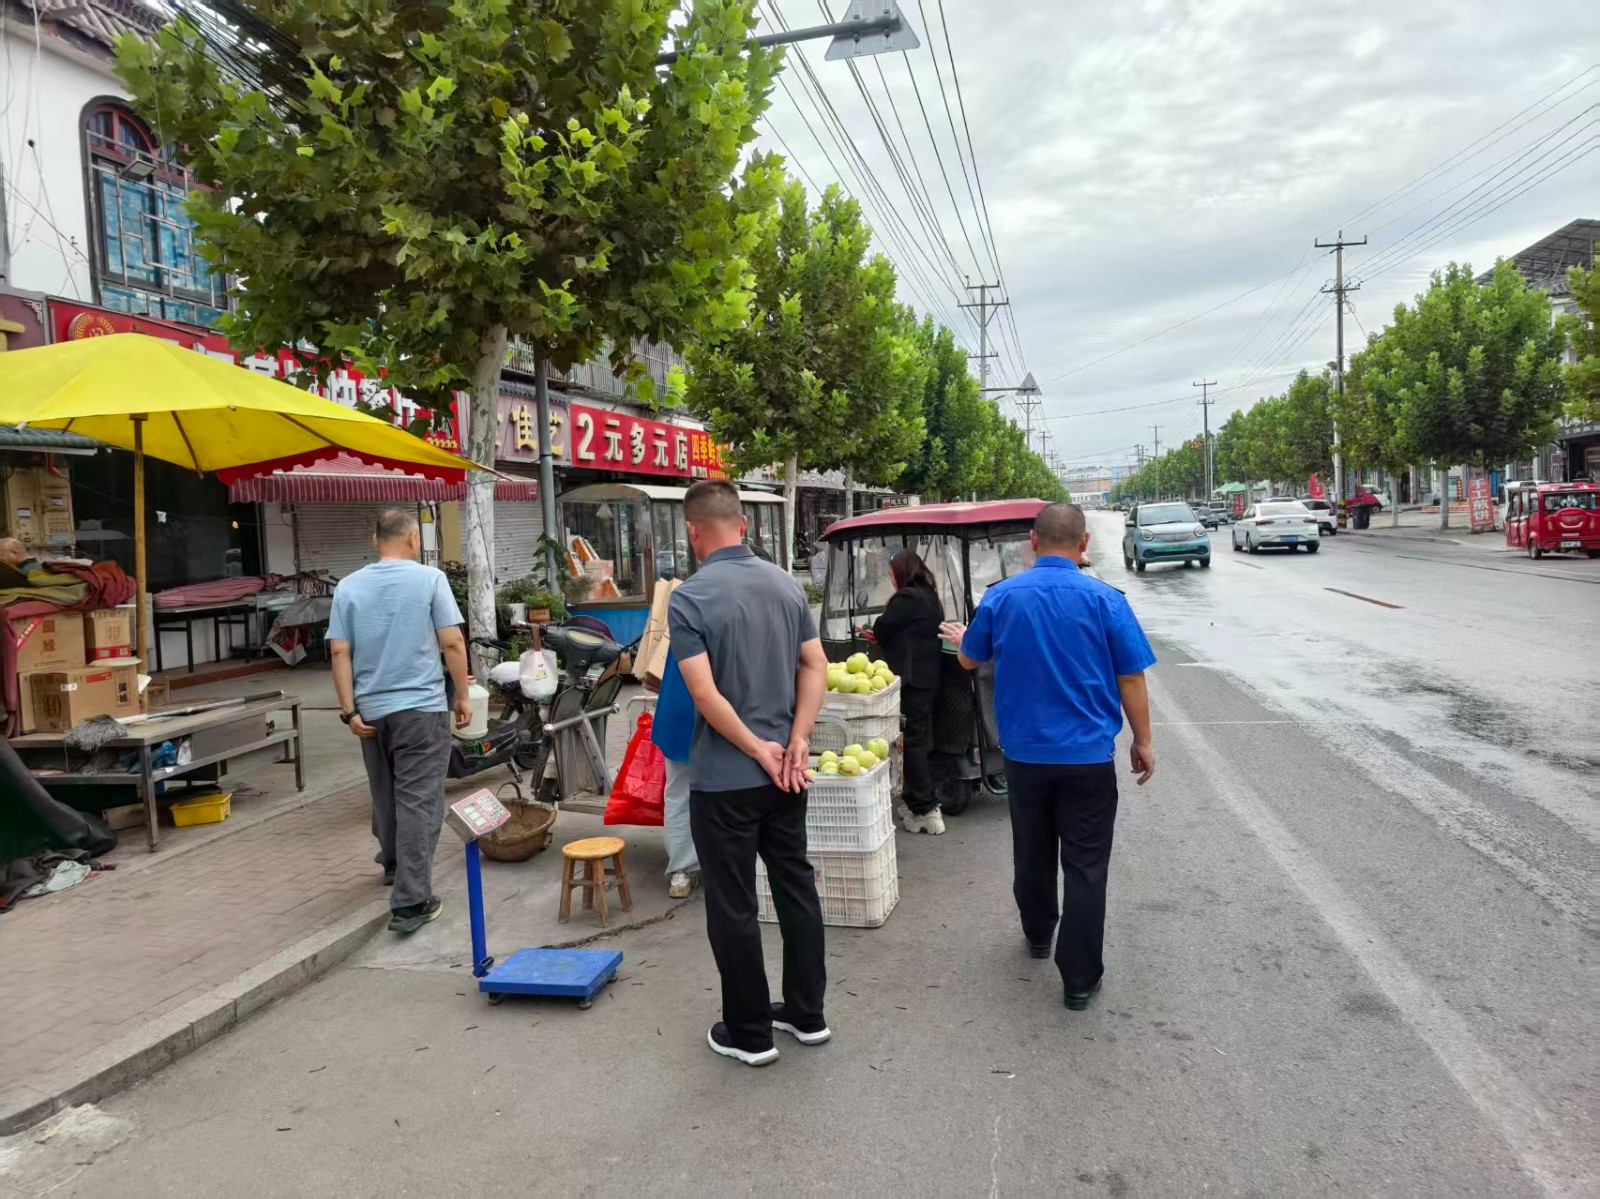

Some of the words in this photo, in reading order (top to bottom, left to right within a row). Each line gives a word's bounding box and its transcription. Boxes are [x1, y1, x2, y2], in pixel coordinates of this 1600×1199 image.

[496, 405, 565, 456] 佳艺
[577, 413, 688, 471] 2元多元店
[1469, 478, 1489, 521] 手工煎饼
